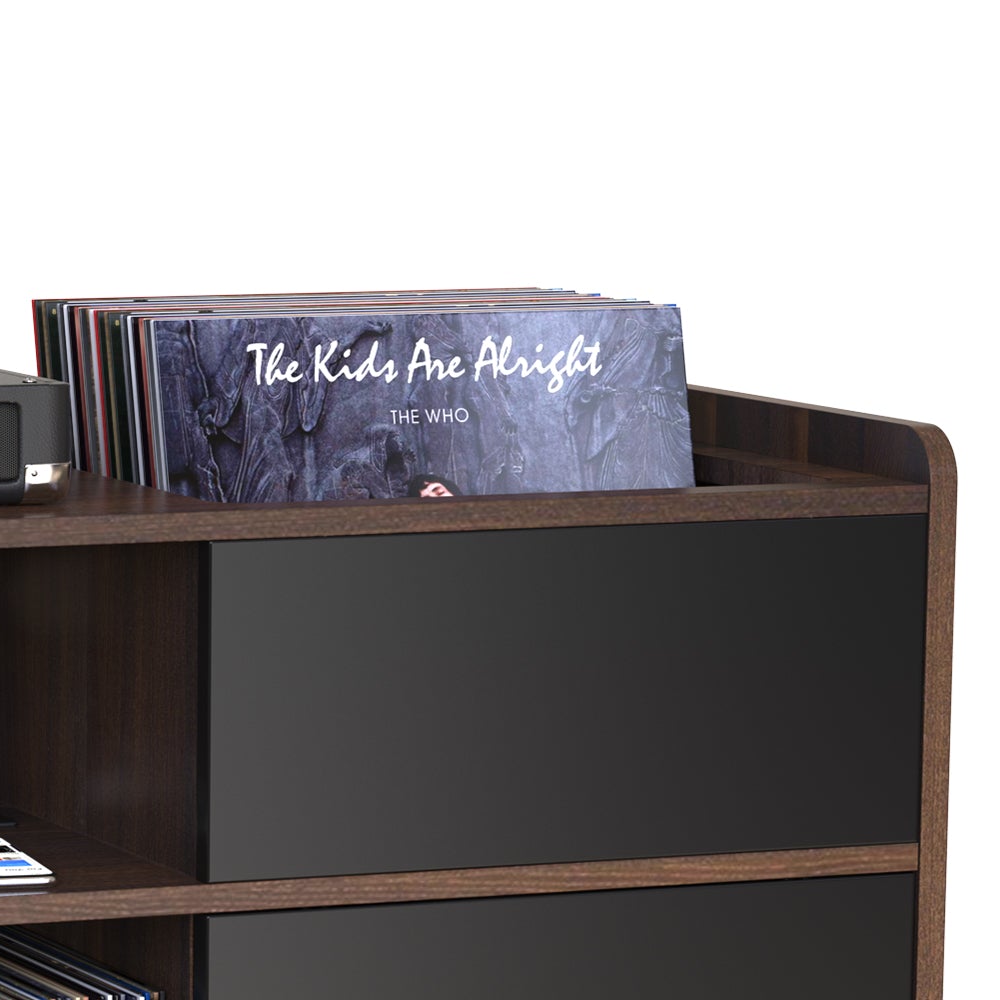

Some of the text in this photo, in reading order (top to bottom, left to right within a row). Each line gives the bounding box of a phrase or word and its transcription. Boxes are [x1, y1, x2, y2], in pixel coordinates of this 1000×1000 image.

[246, 333, 603, 394] The Kids Are Alright
[389, 407, 470, 426] THE WHO
